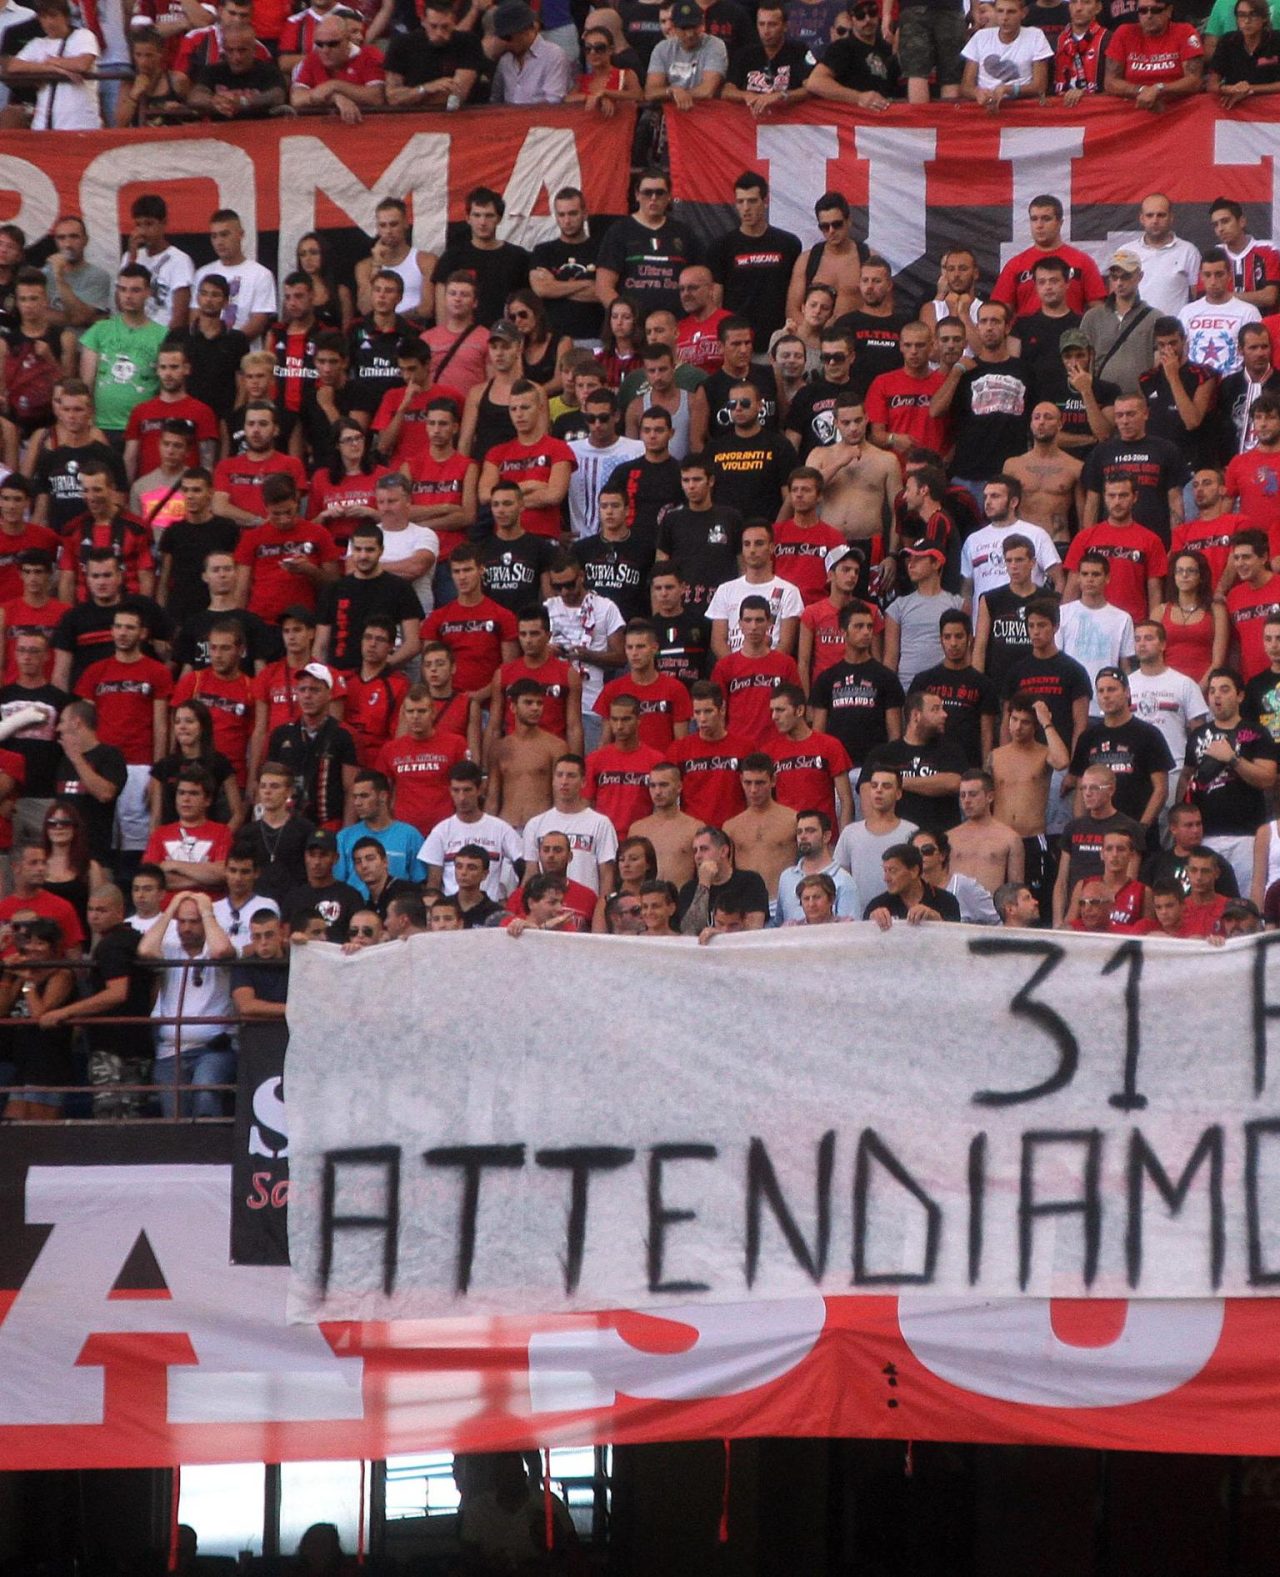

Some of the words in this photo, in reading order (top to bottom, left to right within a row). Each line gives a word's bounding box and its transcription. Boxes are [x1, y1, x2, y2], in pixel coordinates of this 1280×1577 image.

[1131, 61, 1177, 72] ULTRAS
[637, 264, 674, 277] Ultras
[625, 278, 661, 292] Curva
[1189, 318, 1238, 330] OBEY
[358, 366, 402, 378] Emirate
[714, 451, 765, 463] IGNORANTI
[721, 460, 764, 471] VIOLENTI
[513, 562, 535, 584] SUD
[584, 563, 613, 582] CURVA
[614, 562, 640, 585] SUD
[992, 618, 1028, 638] CURVA
[1005, 636, 1033, 645] MILAN
[396, 763, 439, 774] ULTRAS
[967, 939, 1149, 1112] 31
